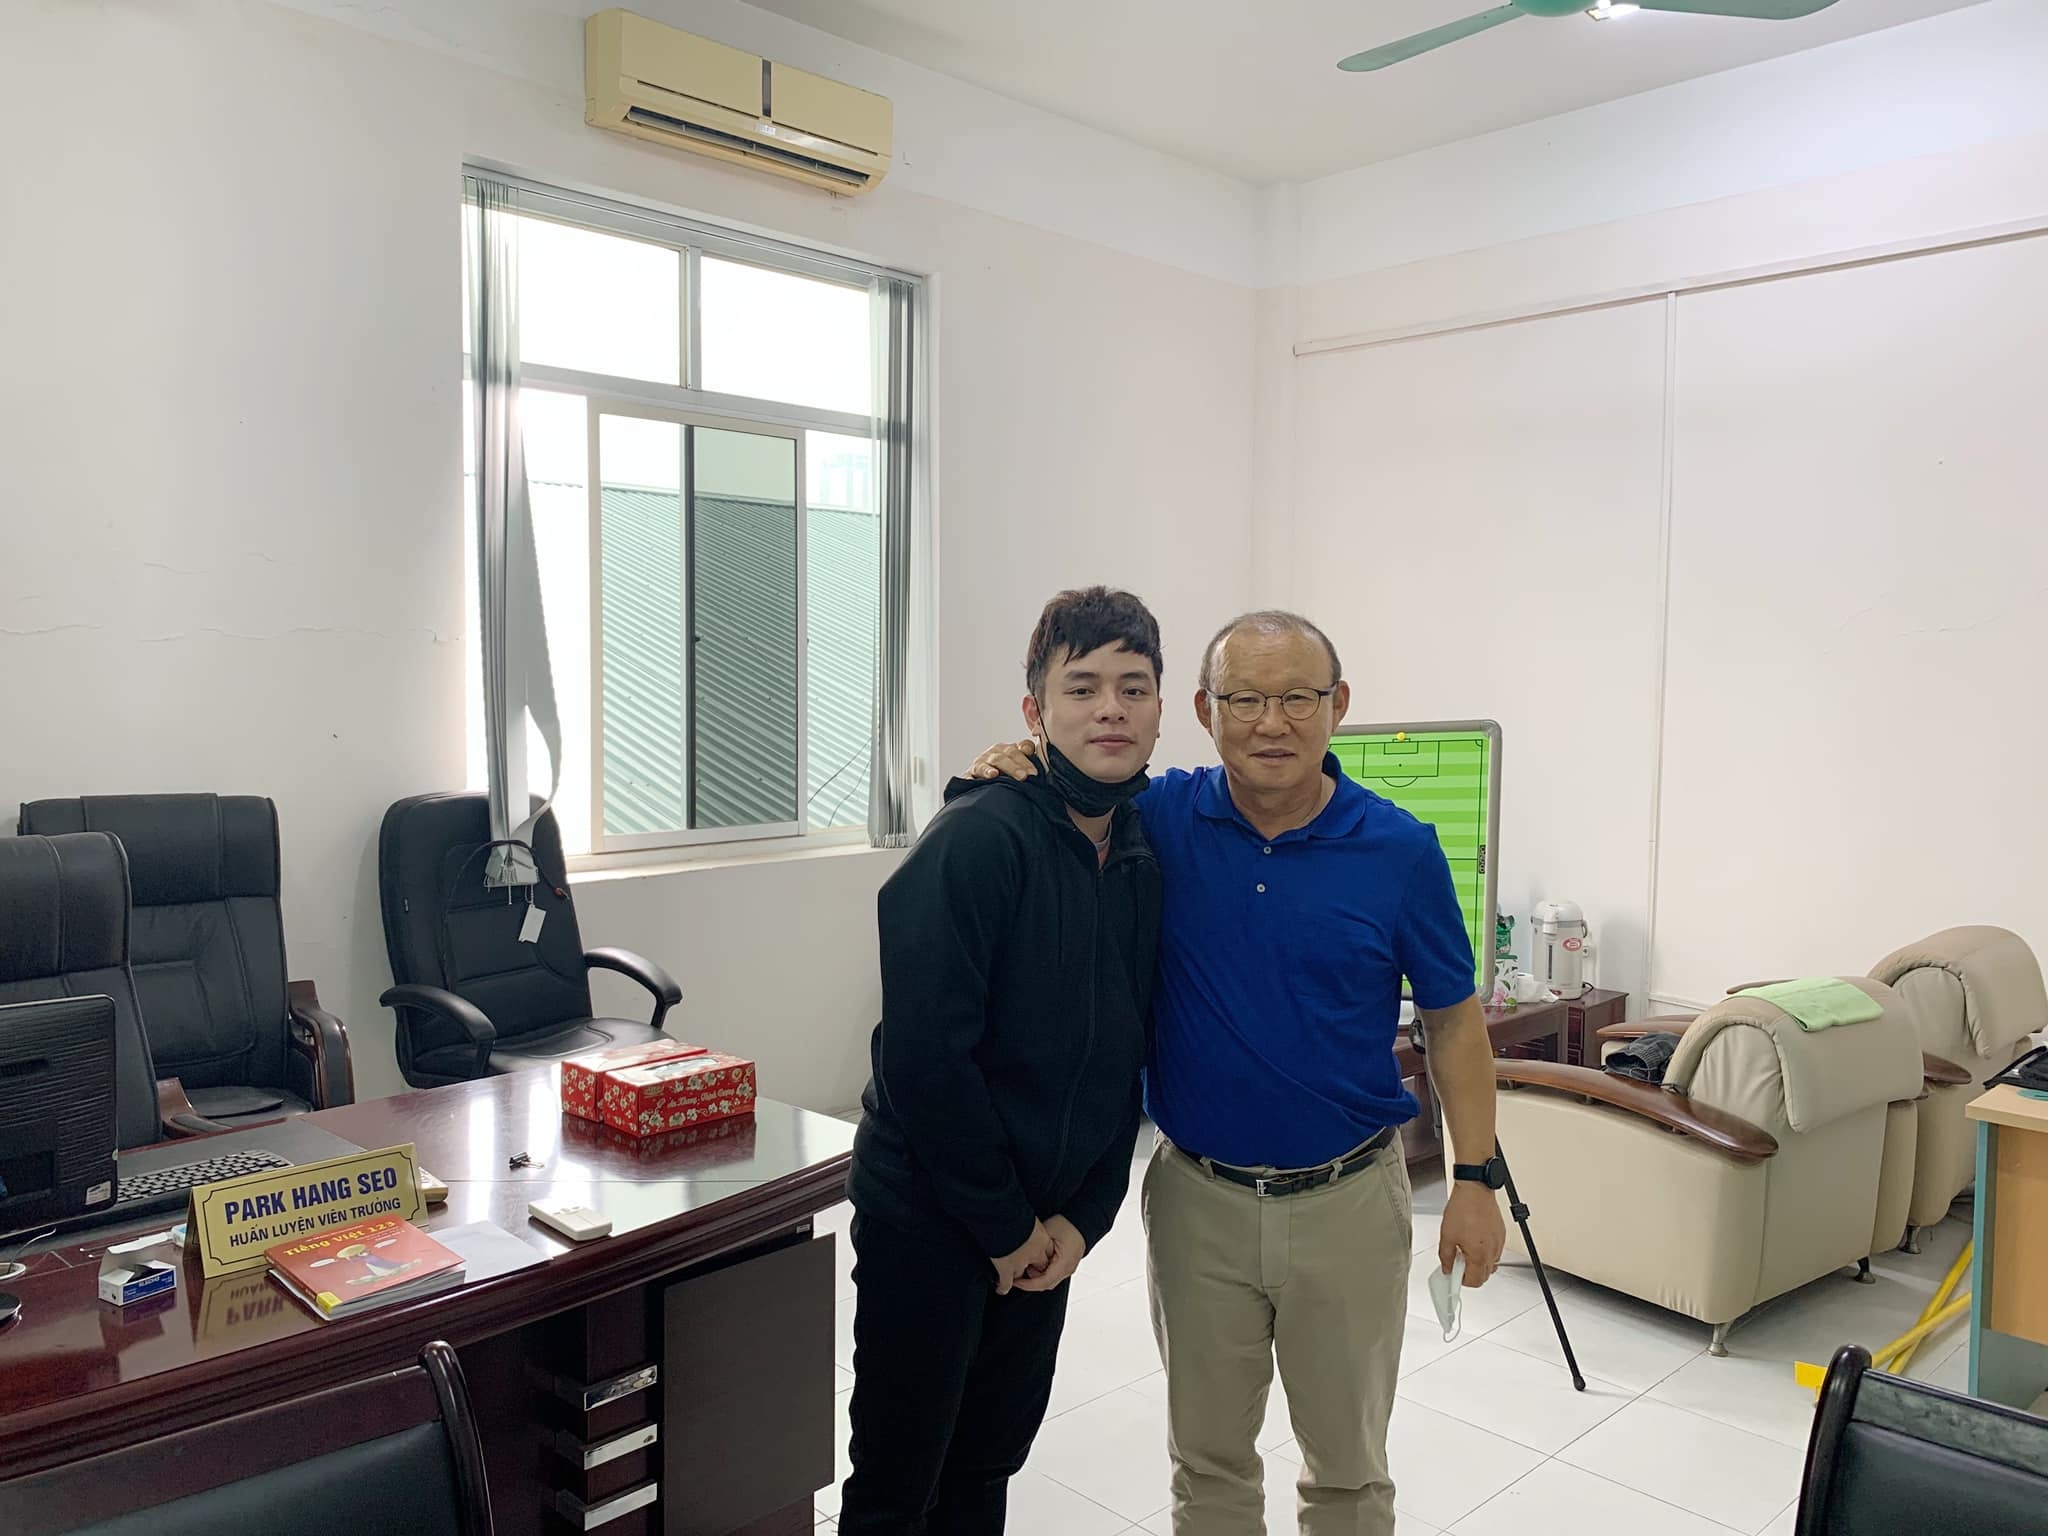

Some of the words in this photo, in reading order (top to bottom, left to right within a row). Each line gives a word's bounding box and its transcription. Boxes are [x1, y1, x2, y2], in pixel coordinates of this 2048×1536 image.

[224, 1190, 286, 1224] PARK
[291, 1177, 352, 1210] HANG
[357, 1167, 397, 1195] SEO
[229, 1223, 269, 1247] HUẤN
[272, 1216, 315, 1237] LUYỆN
[317, 1208, 347, 1226] VIÊN
[350, 1197, 401, 1219] TRƯỞNG
